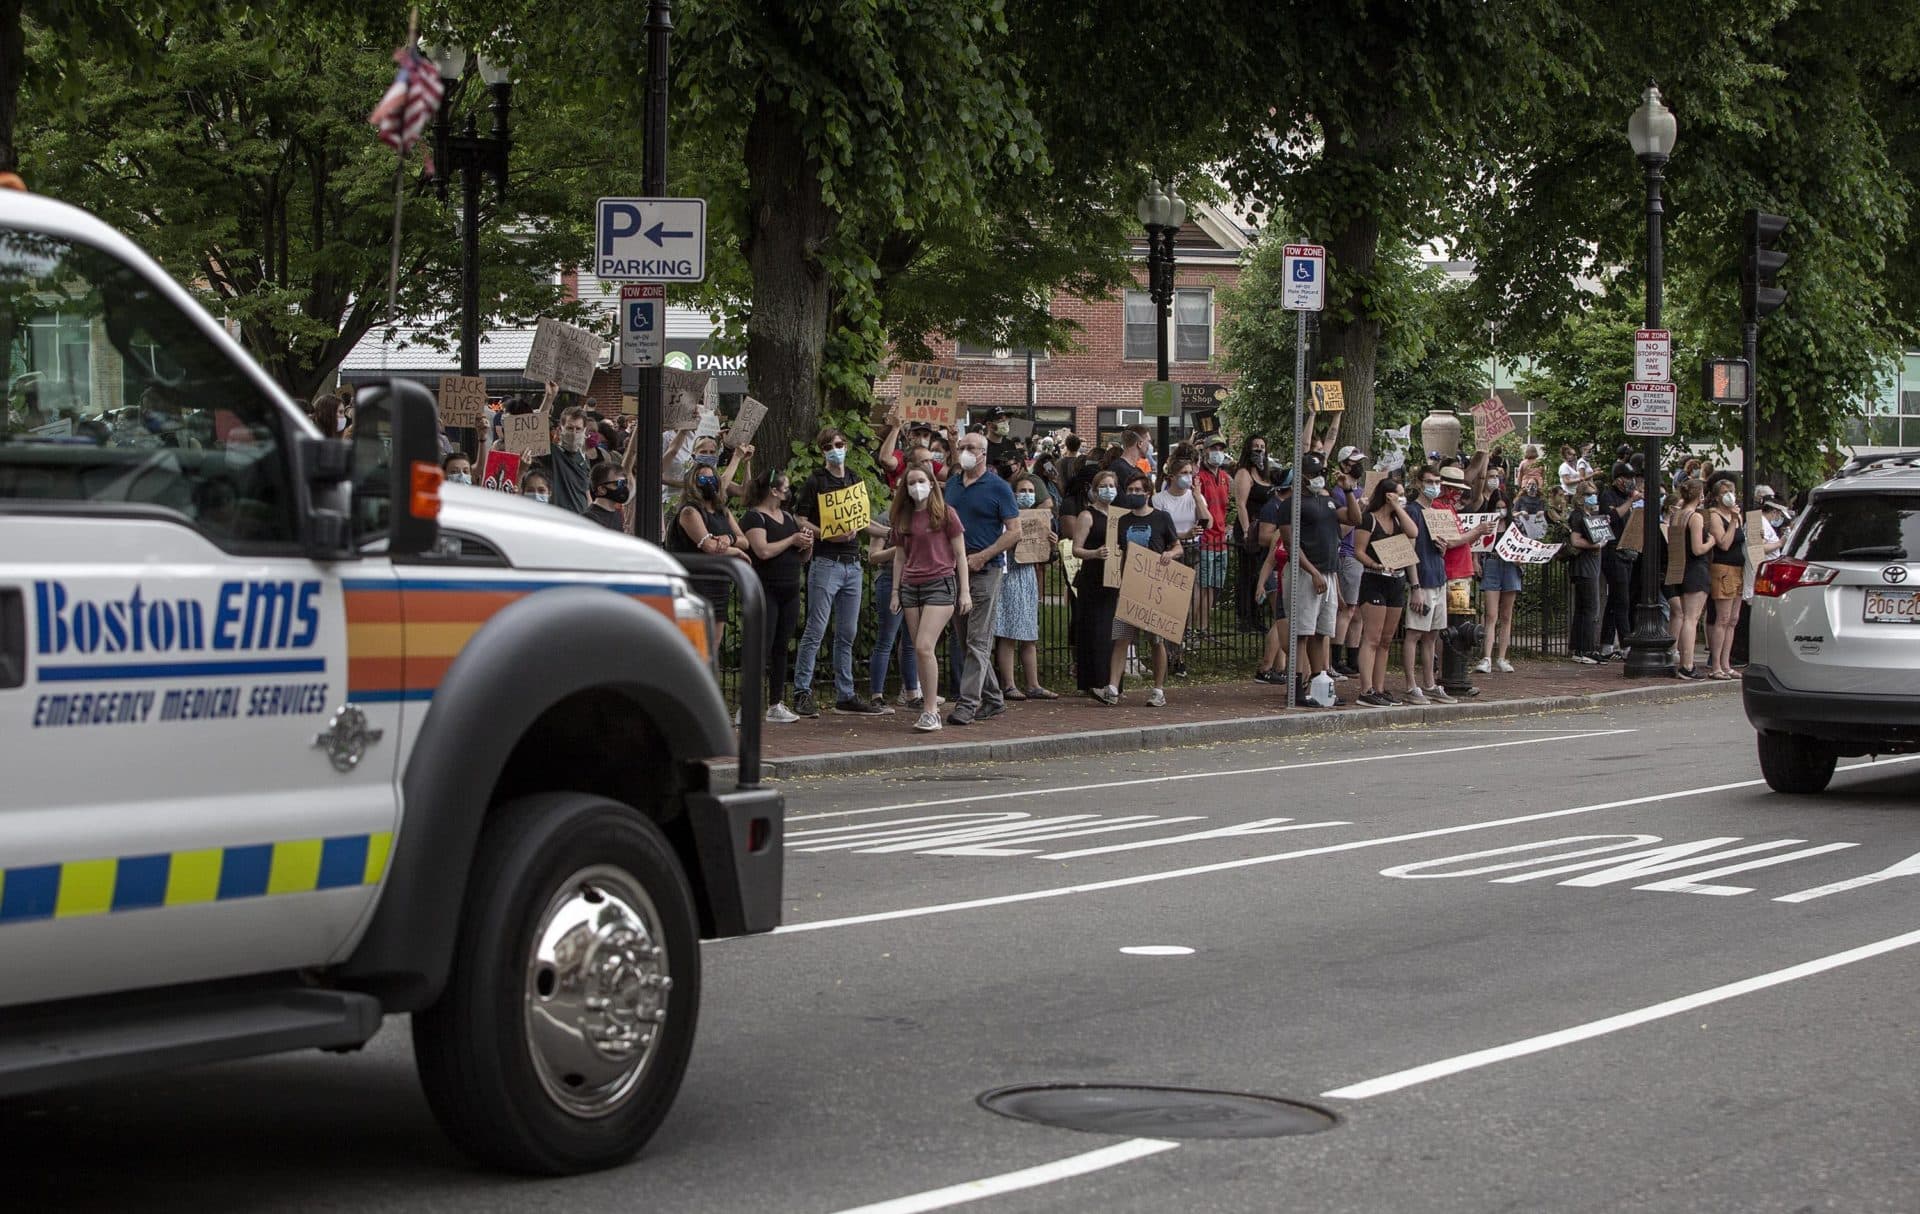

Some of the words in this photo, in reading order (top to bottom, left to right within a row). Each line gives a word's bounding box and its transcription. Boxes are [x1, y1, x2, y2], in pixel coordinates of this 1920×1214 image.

[602, 203, 642, 256] P
[1286, 247, 1301, 256] TOW
[1303, 247, 1322, 257] ZONE
[602, 259, 692, 276] PARKING
[624, 287, 640, 297] TOW
[642, 286, 663, 296] ZONE
[1637, 332, 1650, 340] TOW
[1651, 332, 1667, 340] ZONE
[1645, 343, 1659, 351] NO
[904, 363, 919, 376] WE
[445, 377, 483, 394] BLACK
[919, 377, 940, 385] FOR
[1650, 384, 1673, 392] ZONE
[445, 394, 481, 410] LIVES
[914, 398, 938, 407] AND
[1191, 393, 1213, 404] Shop
[905, 406, 950, 422] LOVE
[514, 415, 540, 432] END
[825, 484, 867, 508] BLACK
[834, 501, 863, 521] LIVES
[821, 513, 869, 538] MATTER
[1499, 544, 1526, 561] UNTIL
[1134, 553, 1190, 592] SILENCE
[1148, 583, 1163, 605] IS
[34, 580, 204, 655] Boston
[212, 580, 322, 651] EMS
[1126, 599, 1180, 635] VIOLENCE
[33, 690, 155, 728] EMERGENCY
[159, 686, 241, 722] MEDICAL
[246, 683, 328, 717] SERVICES
